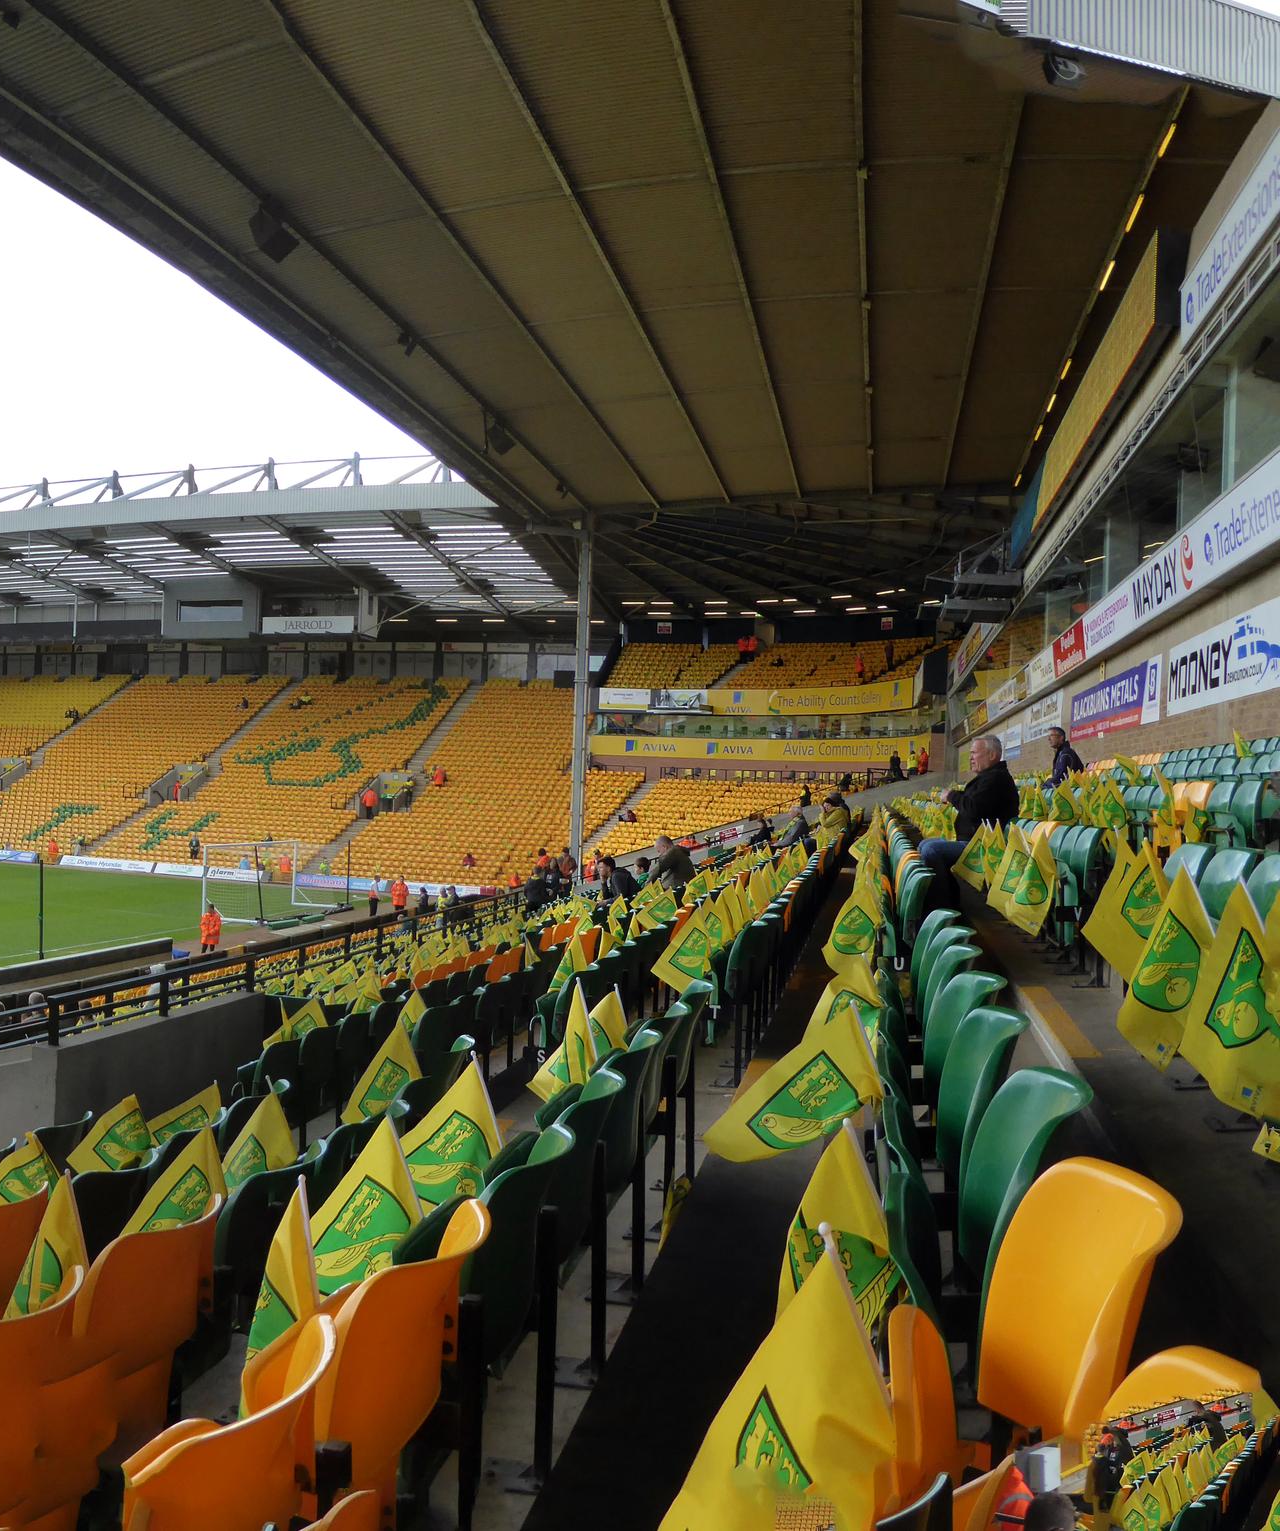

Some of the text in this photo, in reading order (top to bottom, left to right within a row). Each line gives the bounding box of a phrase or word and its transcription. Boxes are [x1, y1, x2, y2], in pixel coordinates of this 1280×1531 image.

[1132, 548, 1177, 620] MAYDAY
[283, 620, 333, 632] JARROLD
[1169, 635, 1232, 702] MOONEY
[777, 696, 794, 706] The
[796, 695, 827, 709] Ability
[829, 694, 860, 706] Counts
[1074, 687, 1110, 721] BLACKBURNS
[1111, 674, 1139, 708] METALS
[643, 744, 676, 752] AVIVA
[722, 745, 753, 754] AVIVA
[783, 742, 815, 756] Aviva
[818, 741, 874, 760] Community
[1074, 907, 1082, 921] V
[894, 957, 905, 971] U
[709, 1004, 721, 1019] T
[536, 1050, 545, 1064] S
